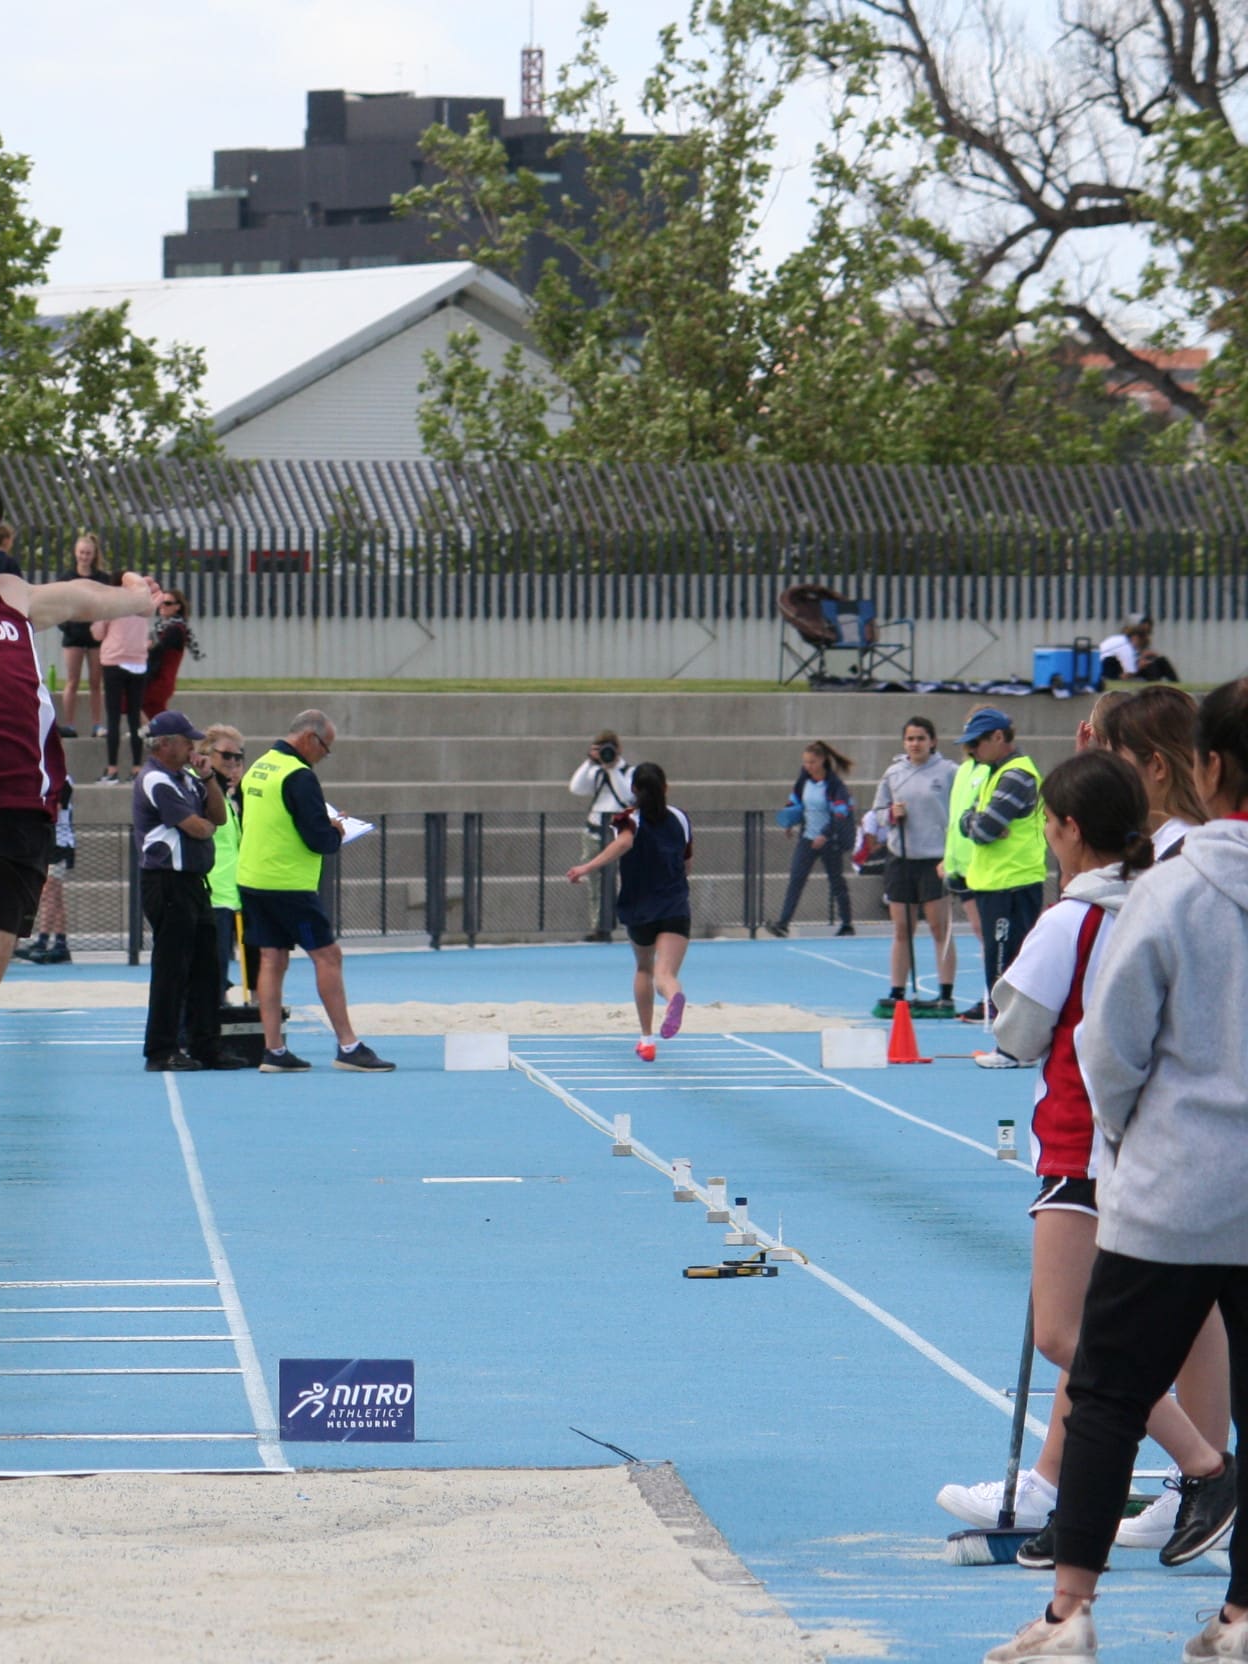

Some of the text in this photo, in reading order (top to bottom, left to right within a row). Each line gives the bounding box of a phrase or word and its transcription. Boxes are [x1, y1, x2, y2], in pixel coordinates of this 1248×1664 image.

[332, 1383, 413, 1406] NITRO
[328, 1408, 404, 1418] ATHLETICS
[327, 1420, 397, 1428] MELBOURNE
